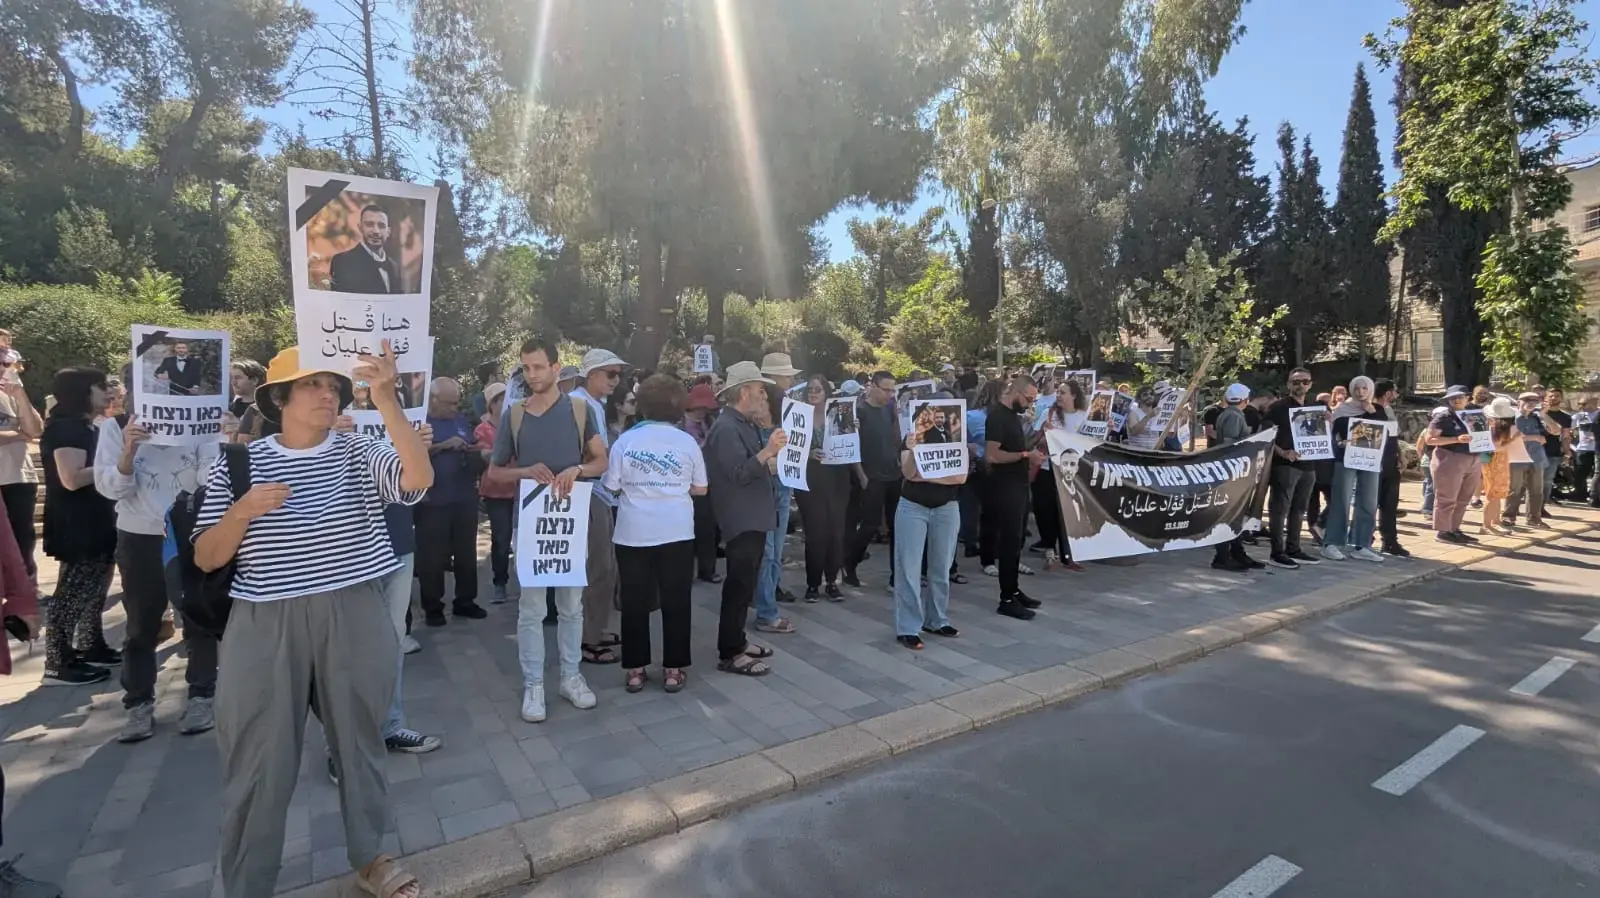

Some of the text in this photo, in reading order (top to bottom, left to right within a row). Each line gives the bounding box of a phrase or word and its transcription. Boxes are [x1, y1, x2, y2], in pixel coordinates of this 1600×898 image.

[382, 311, 411, 332] هنا
[152, 405, 192, 421] נרצח
[197, 406, 223, 422] כאן
[792, 412, 805, 428] כאן
[188, 422, 221, 435] פואד
[788, 430, 806, 448] נרצח
[787, 448, 802, 463] פואד
[922, 450, 944, 461] נרצח
[946, 449, 962, 459] כאן
[942, 459, 962, 469] פואד
[1225, 456, 1250, 481] כאן
[1148, 465, 1189, 487] פואד
[1184, 460, 1229, 485] נרצח
[544, 494, 571, 514] כאן
[1160, 494, 1184, 517] فؤاد
[1213, 490, 1229, 506] هنا
[535, 517, 575, 535] נרצח
[537, 539, 570, 555] פואד
[532, 558, 571, 576] עליאן
